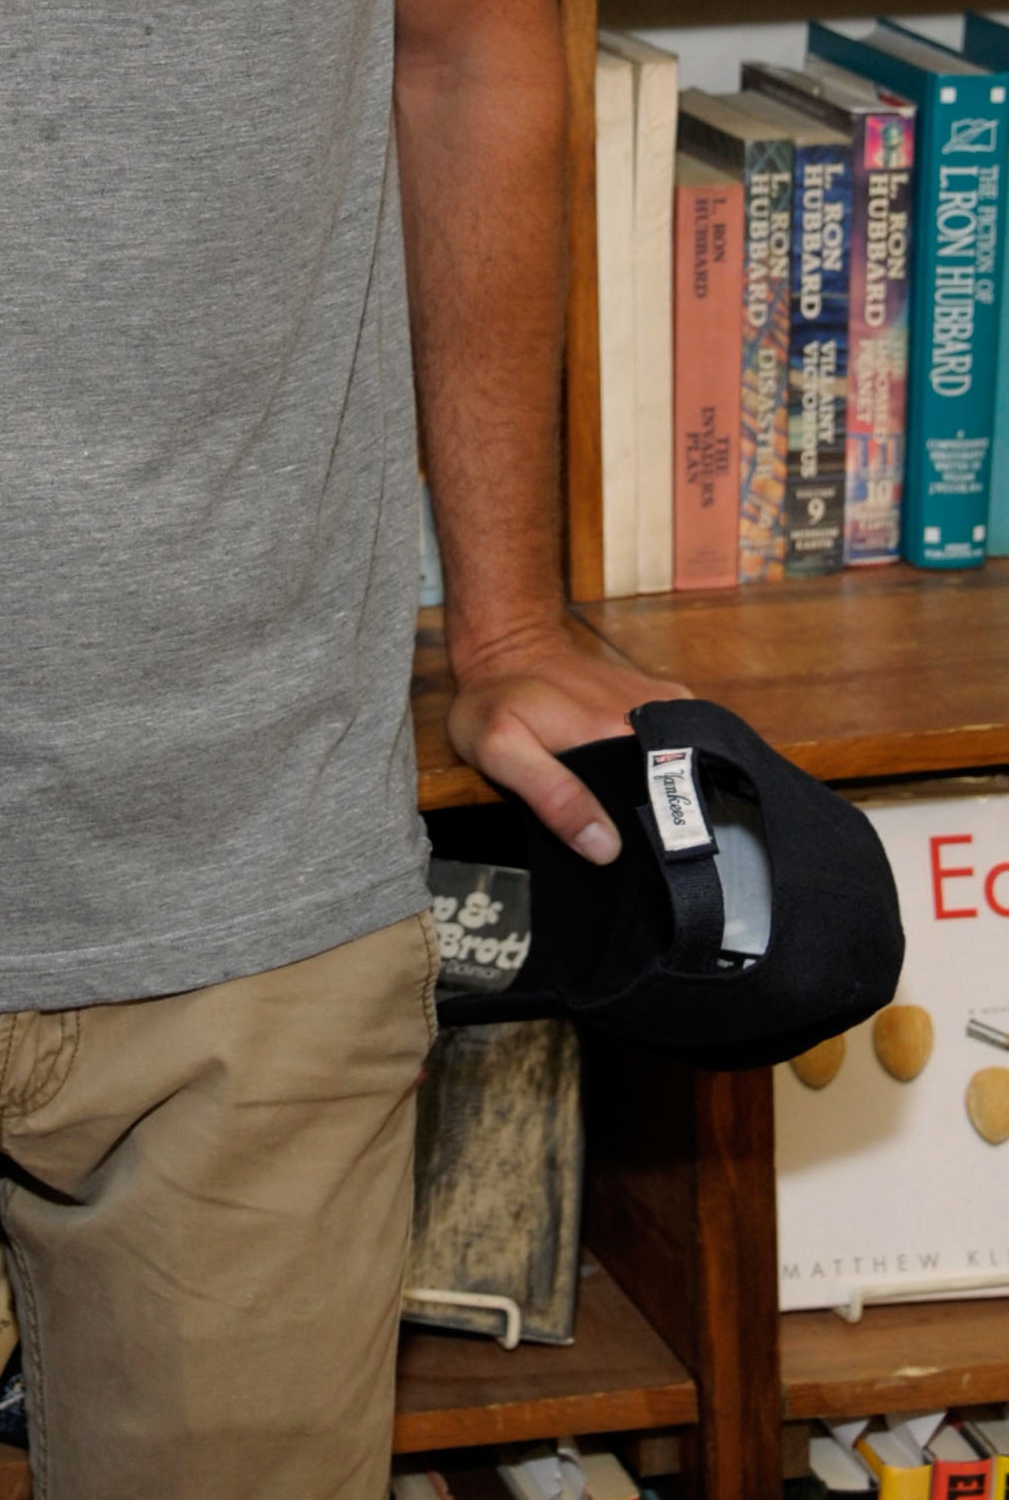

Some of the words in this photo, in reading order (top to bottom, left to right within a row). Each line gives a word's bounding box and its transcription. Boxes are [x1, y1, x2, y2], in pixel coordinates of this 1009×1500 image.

[770, 171, 792, 199] L.
[822, 161, 845, 191] L.
[889, 171, 910, 200] L.
[978, 164, 1000, 200] THE
[693, 198, 709, 299] HUBBARD
[711, 223, 727, 264] RON
[768, 211, 790, 278] RON
[800, 163, 824, 320] HUBBARD
[821, 202, 845, 272] RON
[864, 172, 890, 328] HUBBARD
[886, 210, 908, 280] RON
[936, 189, 978, 258] RON
[747, 173, 771, 328] HUBBARD
[973, 277, 995, 305] OF
[929, 264, 975, 398] HUBBARD
[686, 432, 701, 485] PLAN
[716, 436, 730, 477] THE
[806, 497, 826, 526] 9
[654, 768, 692, 828] Yankees
[456, 890, 504, 931] &
[781, 1253, 940, 1279] MATTHEW
